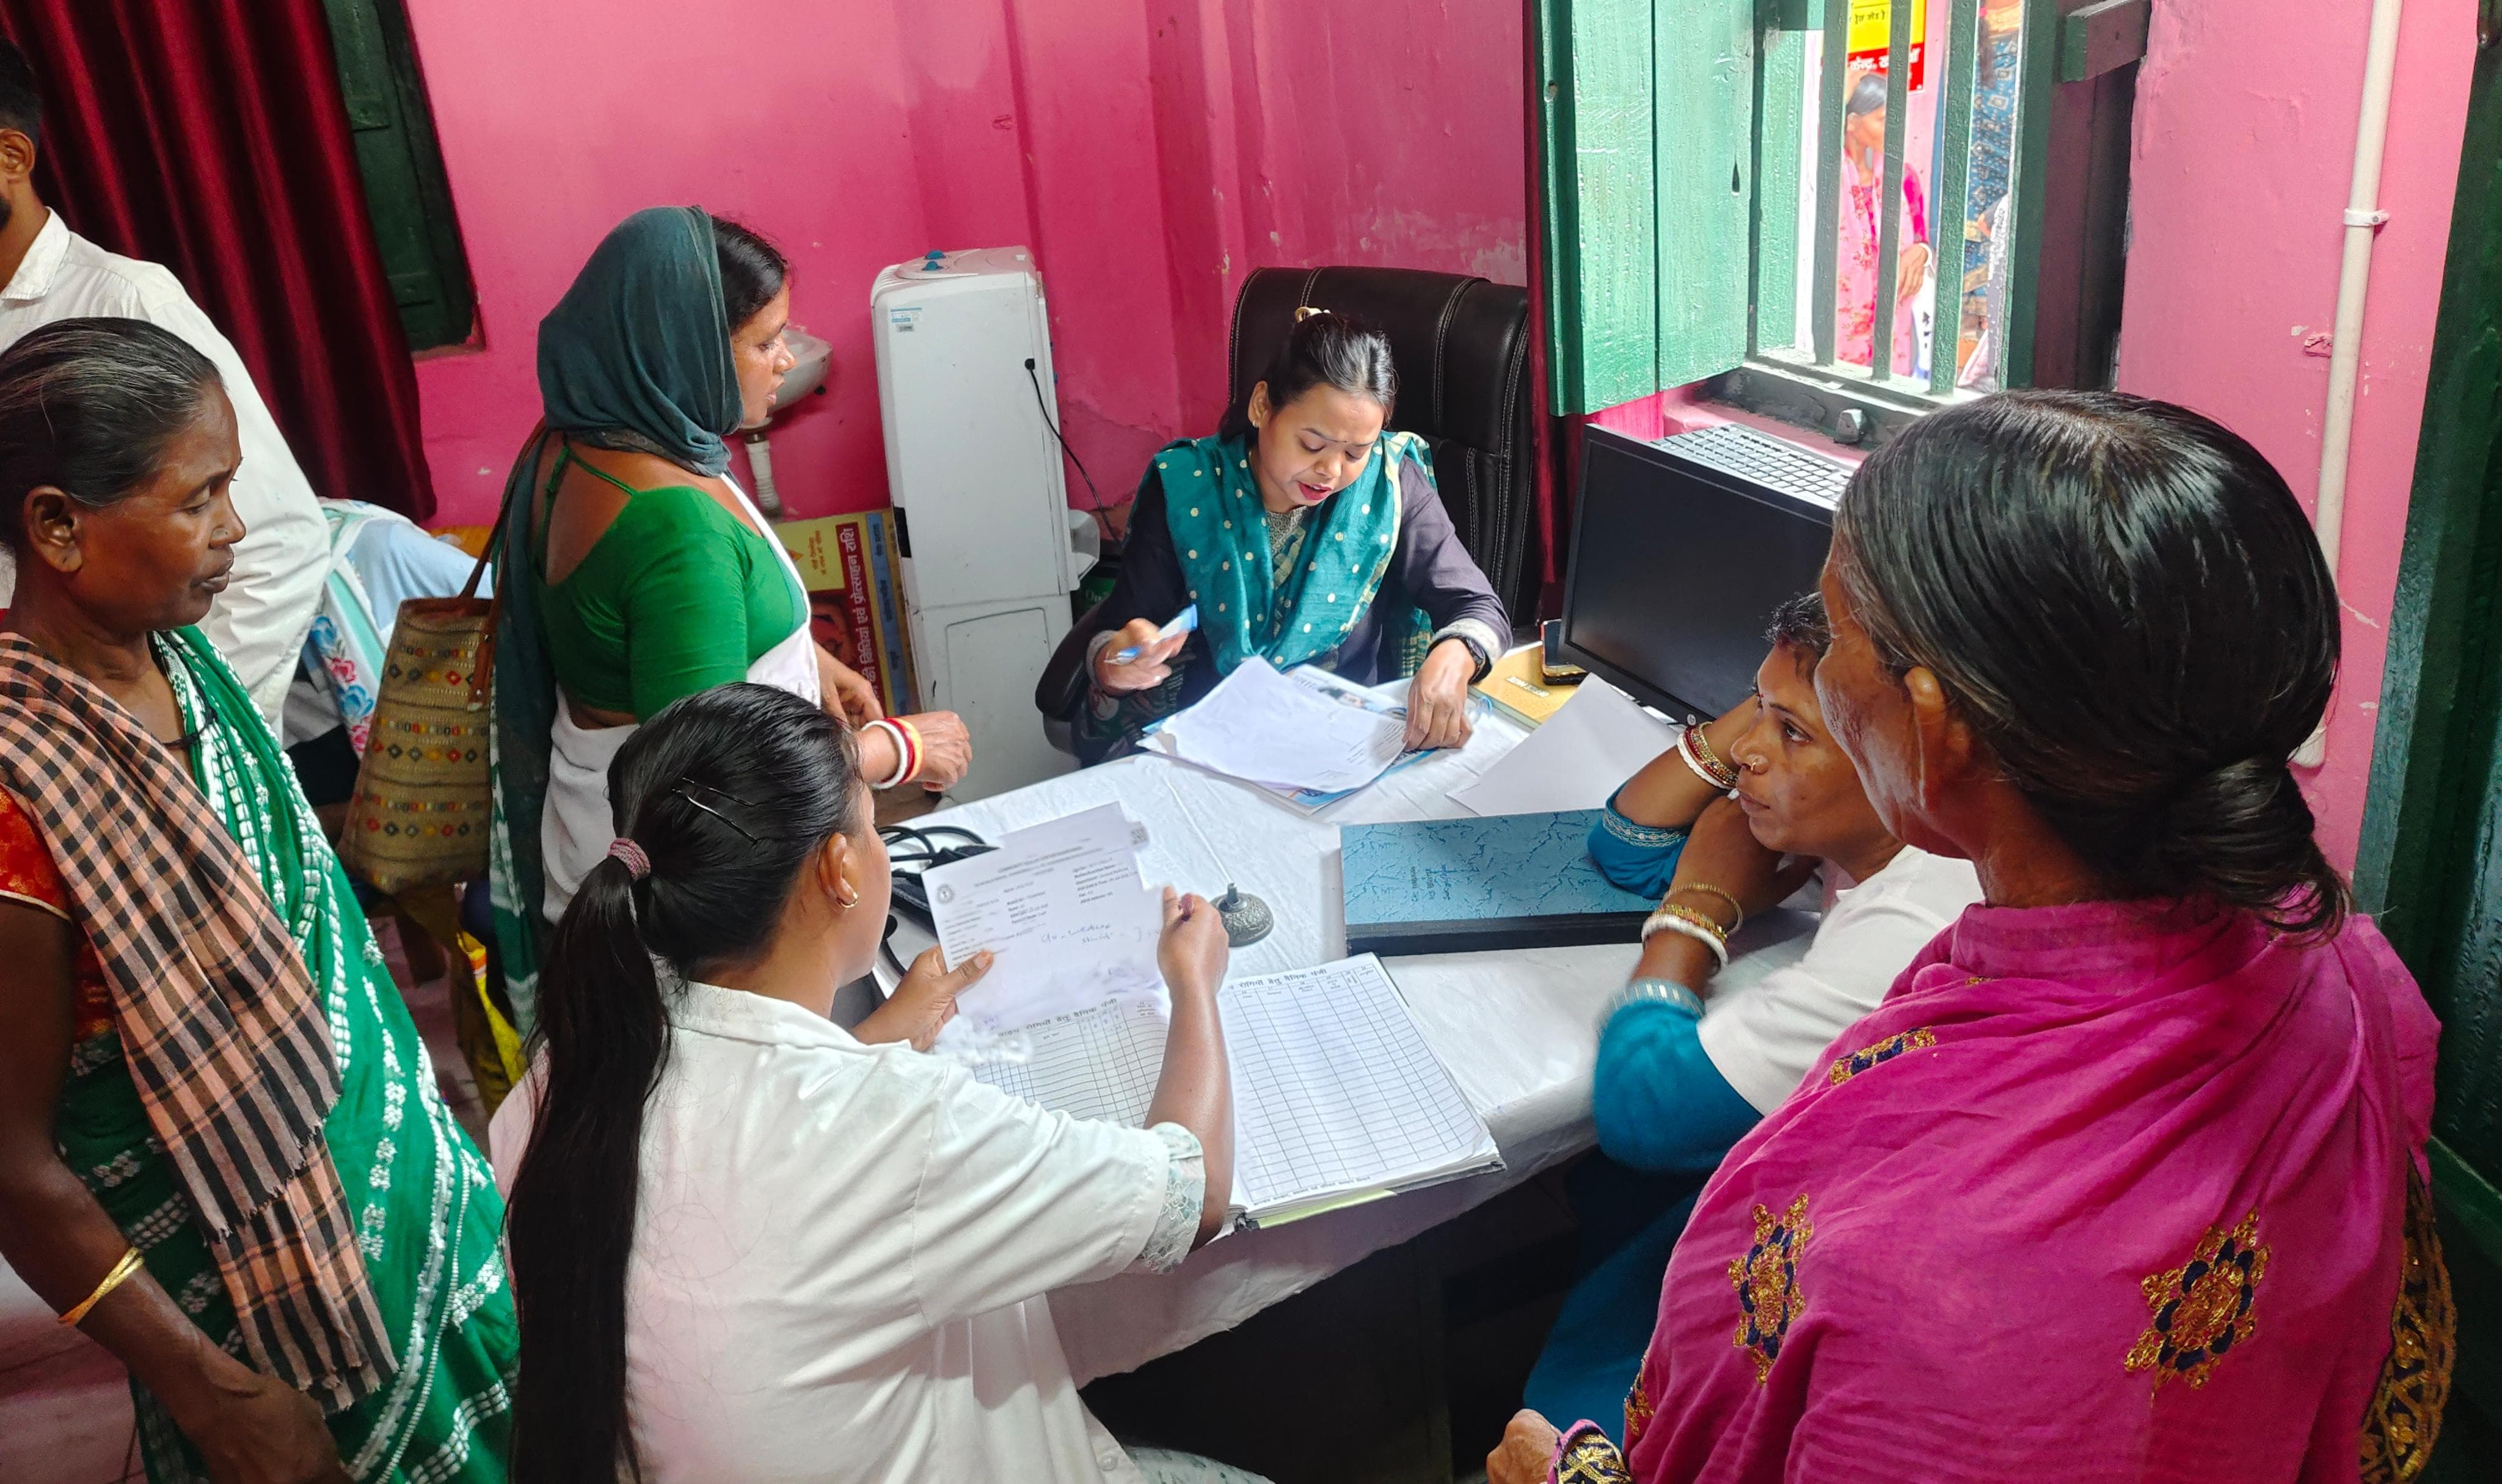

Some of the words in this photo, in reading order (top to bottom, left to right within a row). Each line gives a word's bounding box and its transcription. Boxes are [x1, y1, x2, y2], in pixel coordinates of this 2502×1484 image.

[839, 528, 856, 553] राशि
[847, 554, 866, 605] प्रोत्साहन
[852, 608, 869, 625] एवं
[1267, 977, 1283, 986] हेतु
